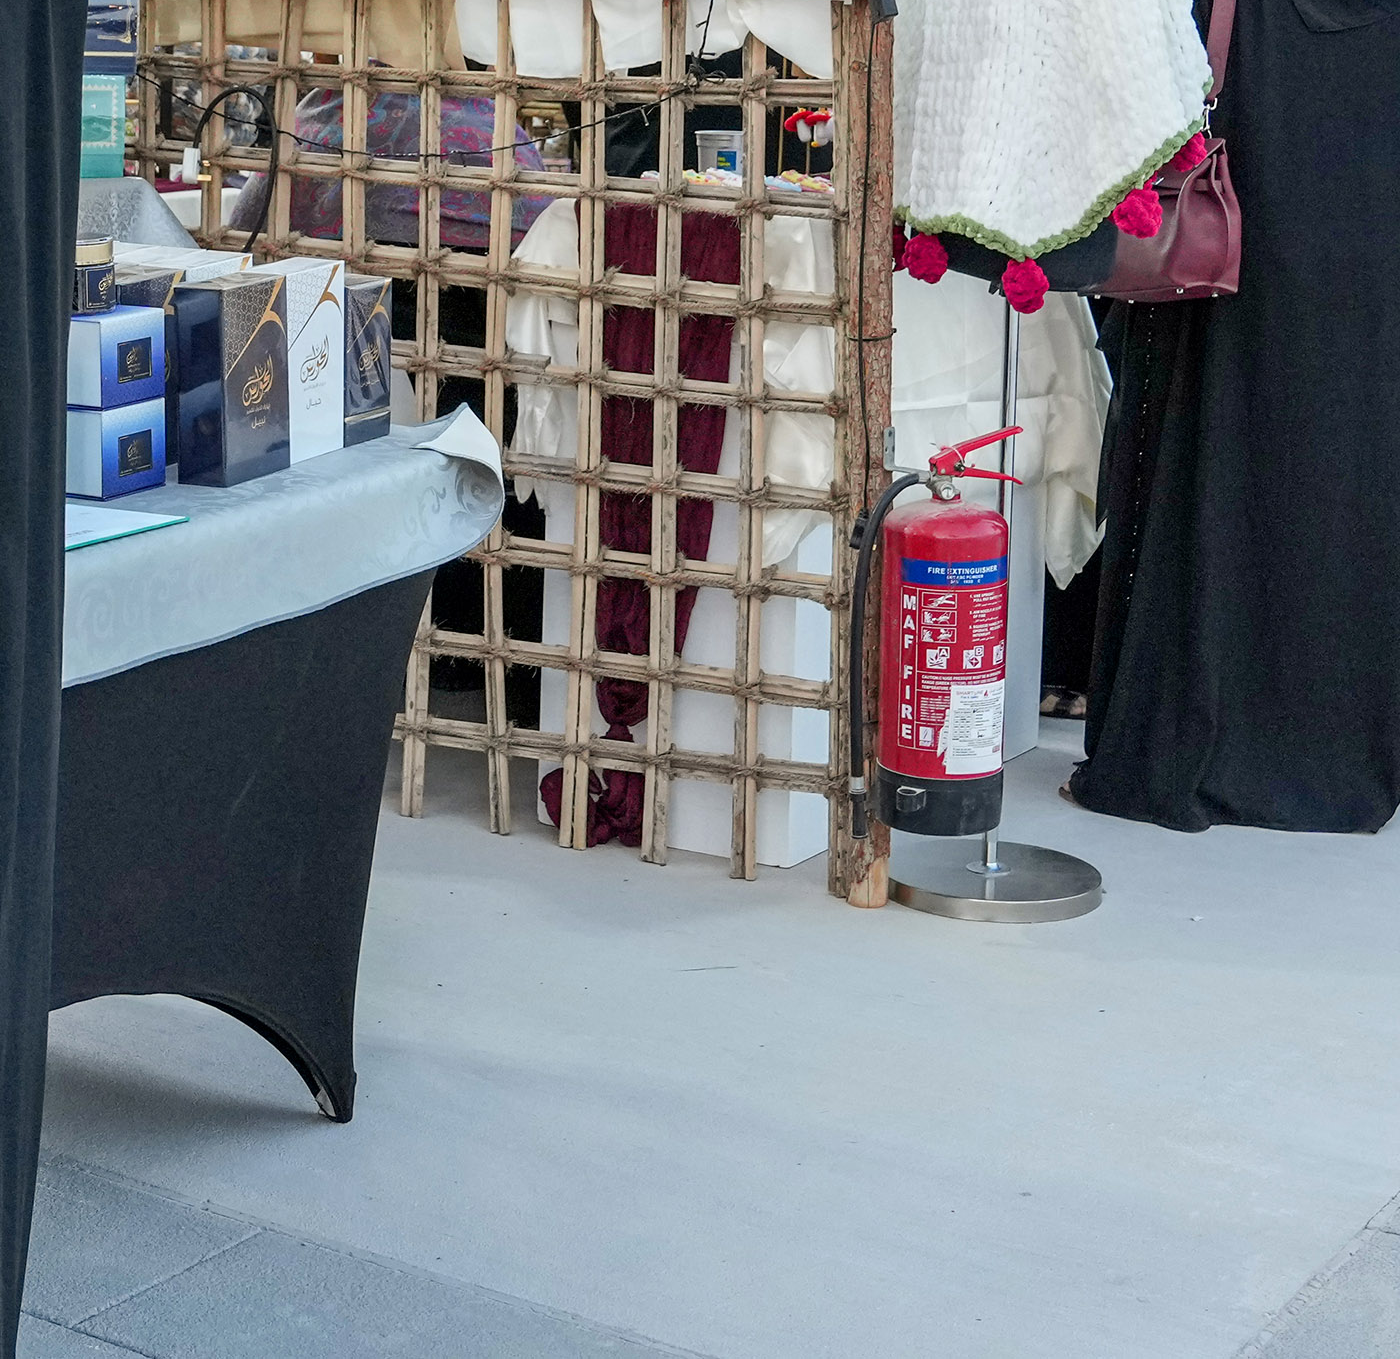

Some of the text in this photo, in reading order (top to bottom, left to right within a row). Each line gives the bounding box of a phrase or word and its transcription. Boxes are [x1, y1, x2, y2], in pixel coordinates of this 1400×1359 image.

[927, 564, 998, 575] FIRE EXTINGUISHER
[939, 647, 948, 657] A
[975, 647, 983, 656] B
[901, 664, 914, 740] FIRE
